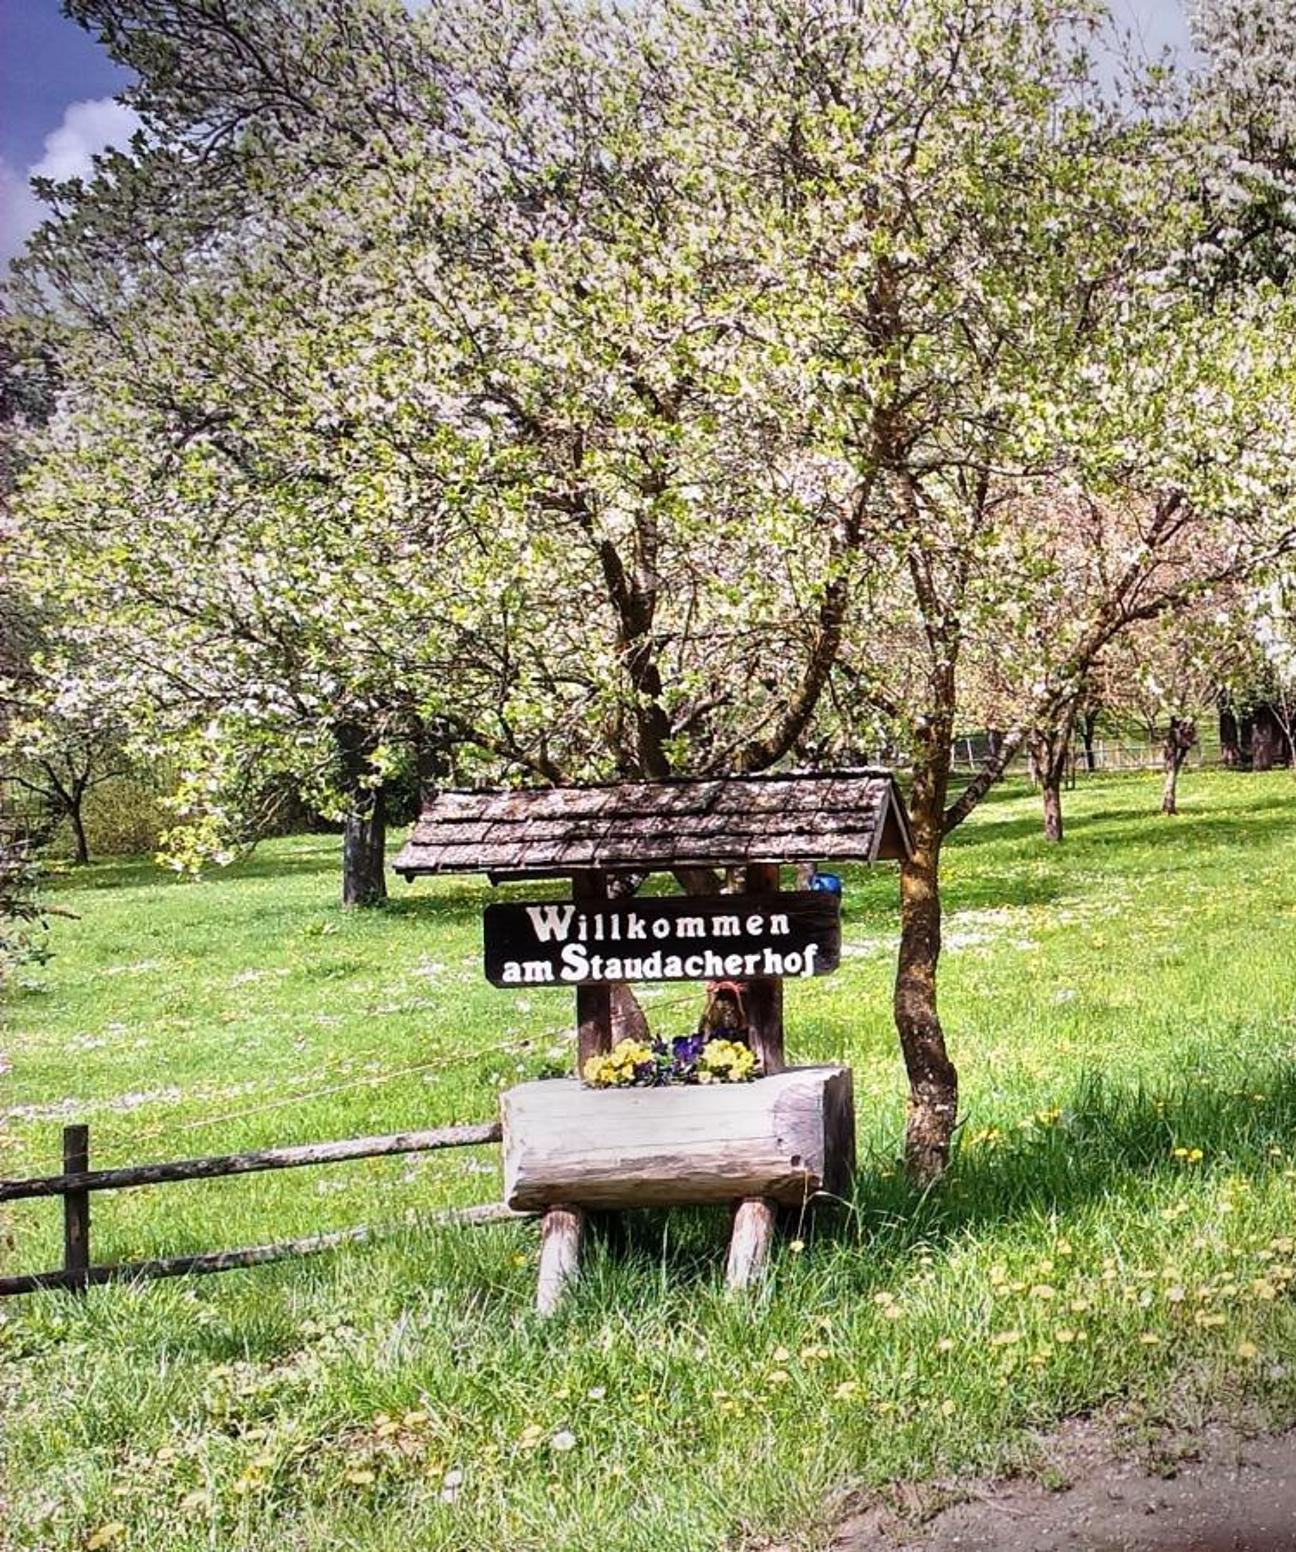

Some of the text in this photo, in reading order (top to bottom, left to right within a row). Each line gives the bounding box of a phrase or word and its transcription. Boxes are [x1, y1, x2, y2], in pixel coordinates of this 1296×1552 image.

[526, 905, 791, 943] Willkommen
[502, 943, 819, 983] am Staudacherhof
